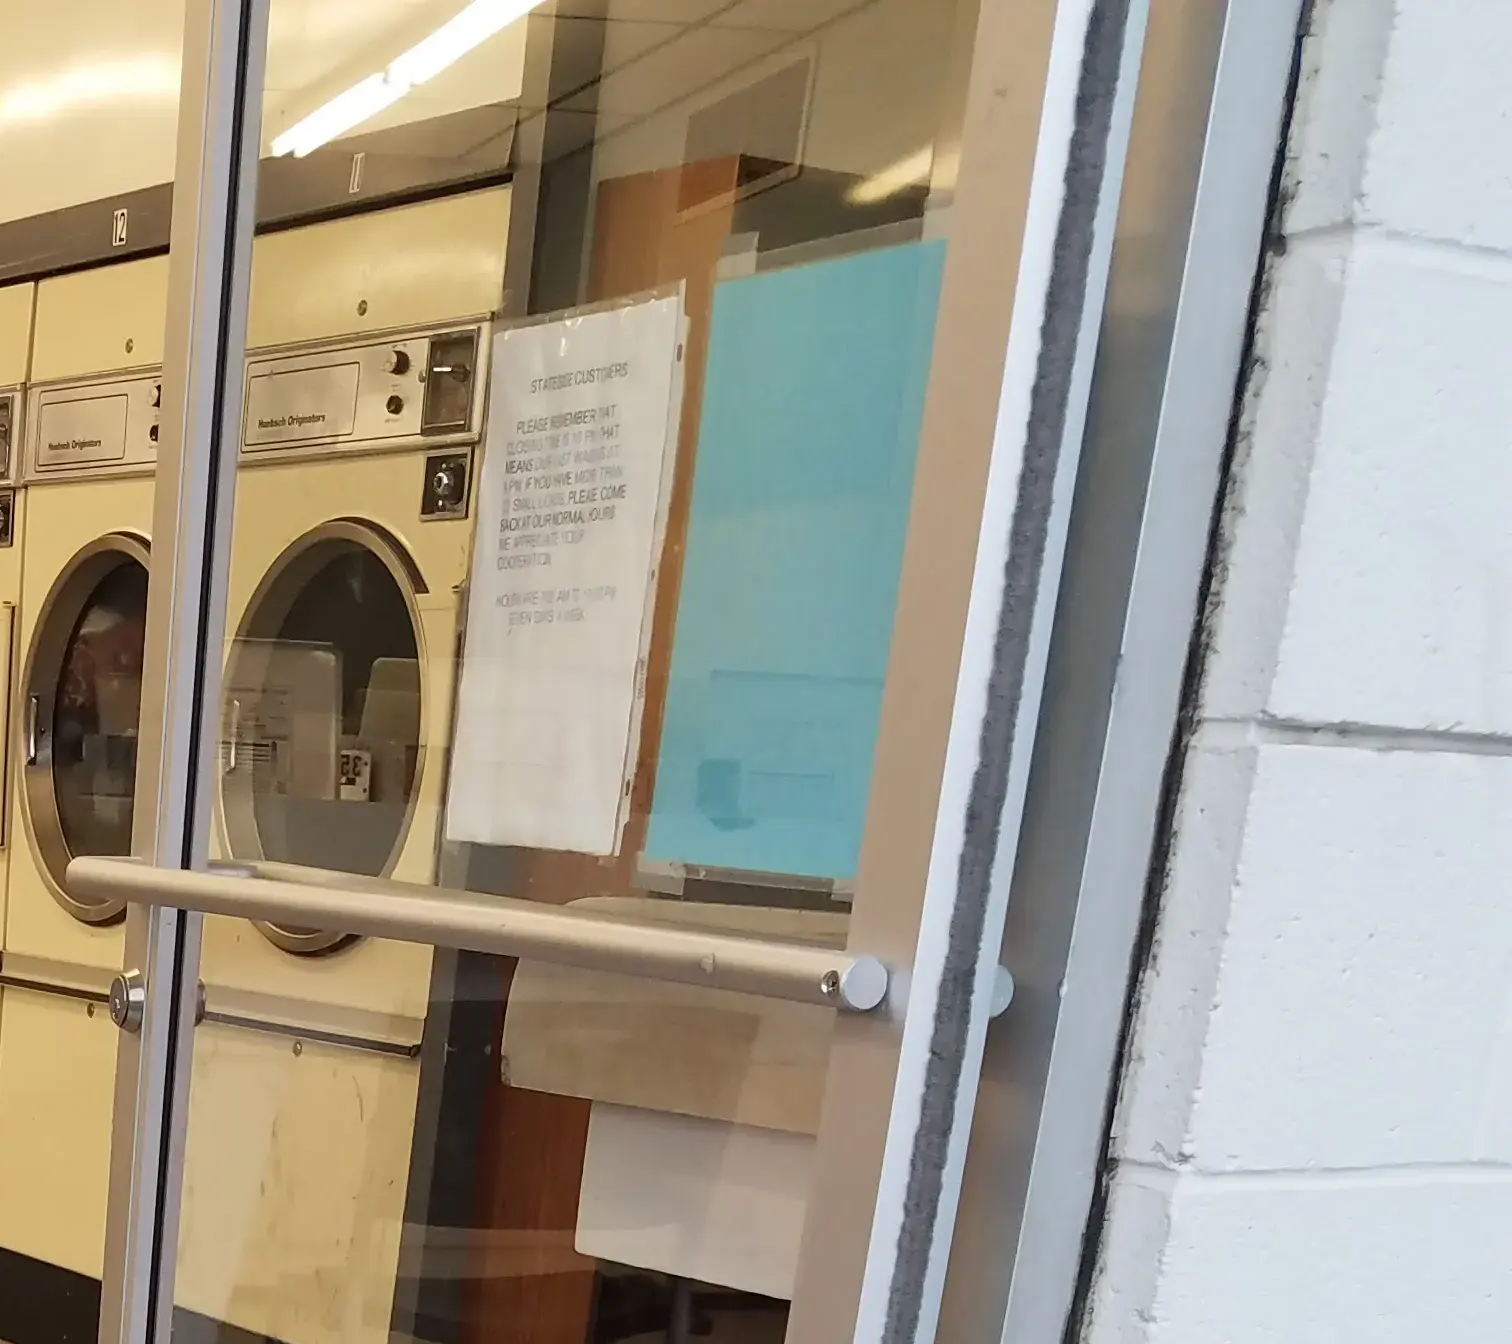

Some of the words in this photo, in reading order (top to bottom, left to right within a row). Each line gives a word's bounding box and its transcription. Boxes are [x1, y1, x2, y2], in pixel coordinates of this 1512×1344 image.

[114, 211, 127, 244] 12
[574, 362, 629, 386] CUSTOMERS
[516, 417, 549, 435] PLEASE
[505, 459, 535, 475] MEANS
[600, 484, 628, 502] COME
[533, 511, 552, 528] OUR
